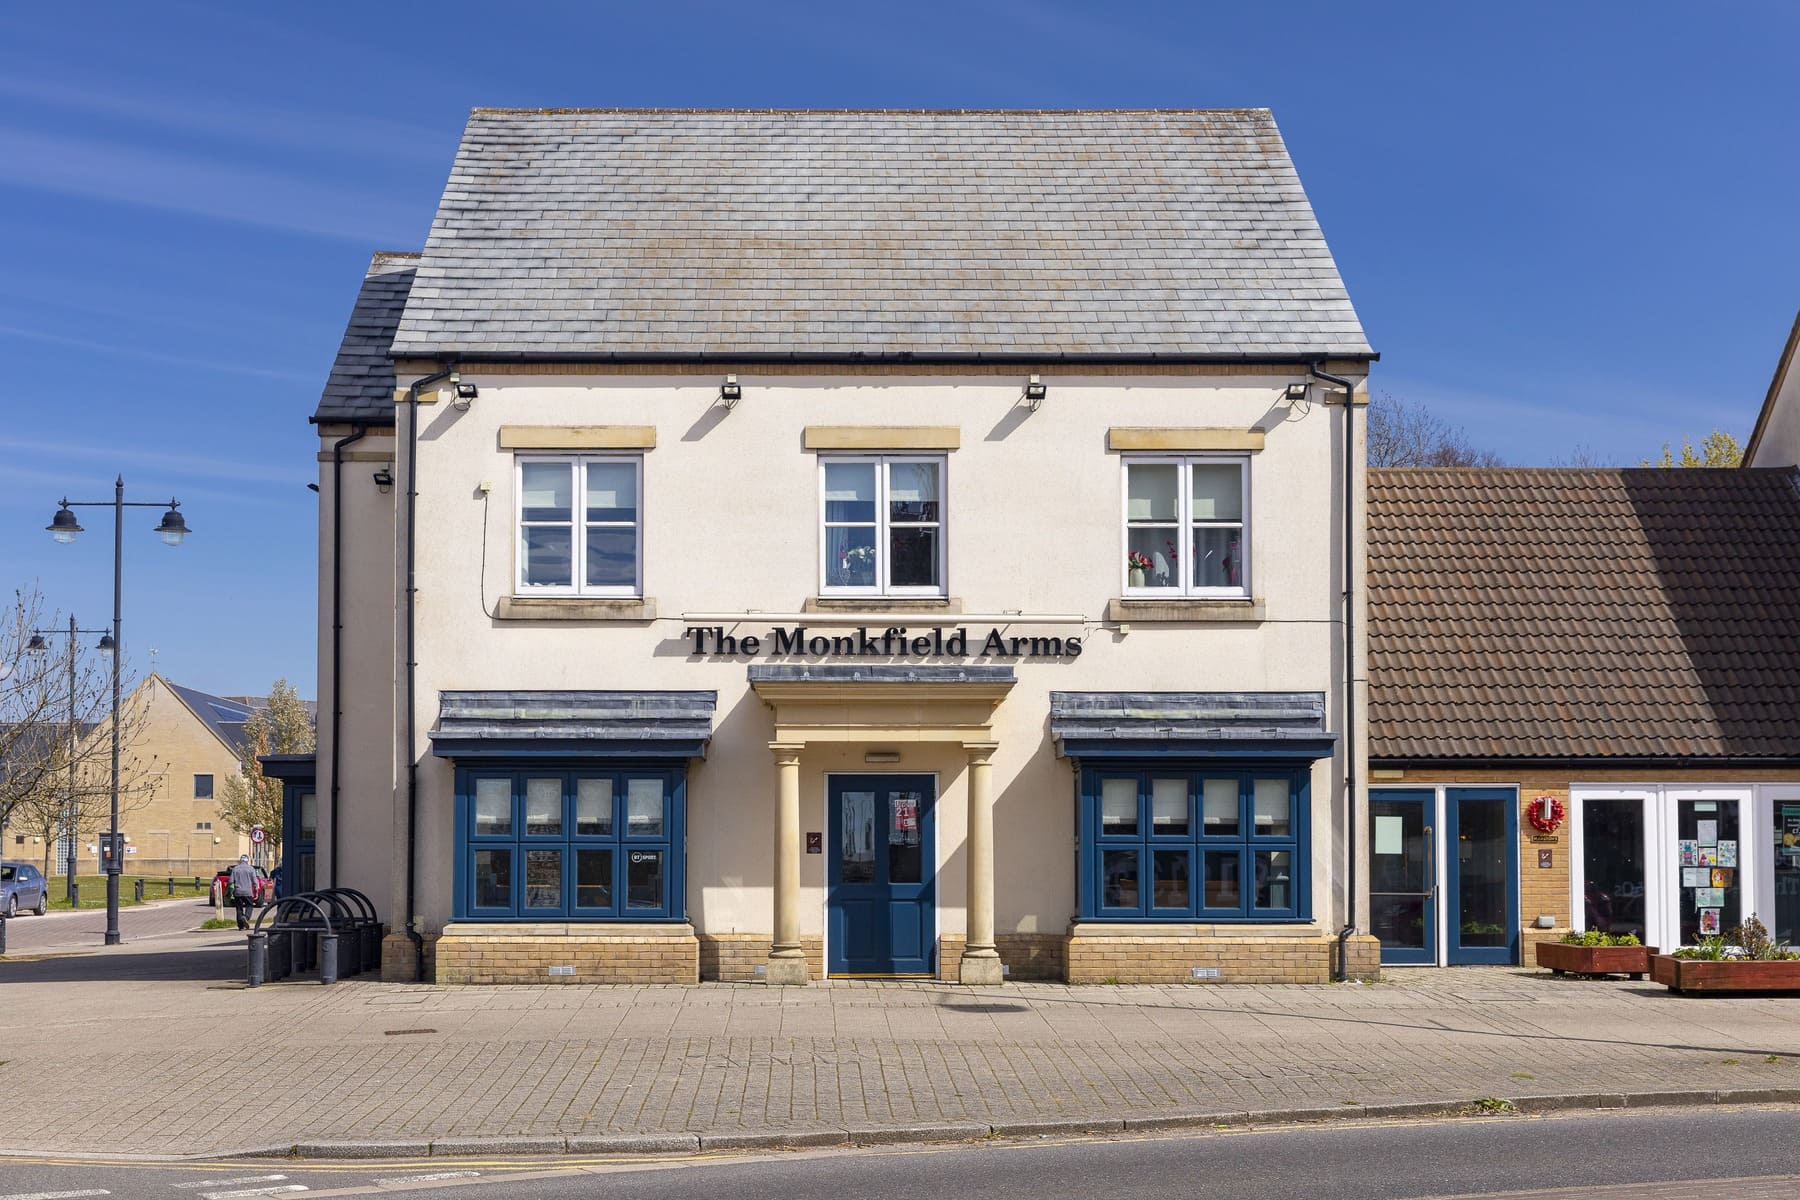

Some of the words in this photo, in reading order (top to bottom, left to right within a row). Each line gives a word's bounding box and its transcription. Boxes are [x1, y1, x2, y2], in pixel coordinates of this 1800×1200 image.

[686, 627, 760, 656] The
[771, 626, 970, 657] Monkfield
[980, 628, 1082, 657] Arms
